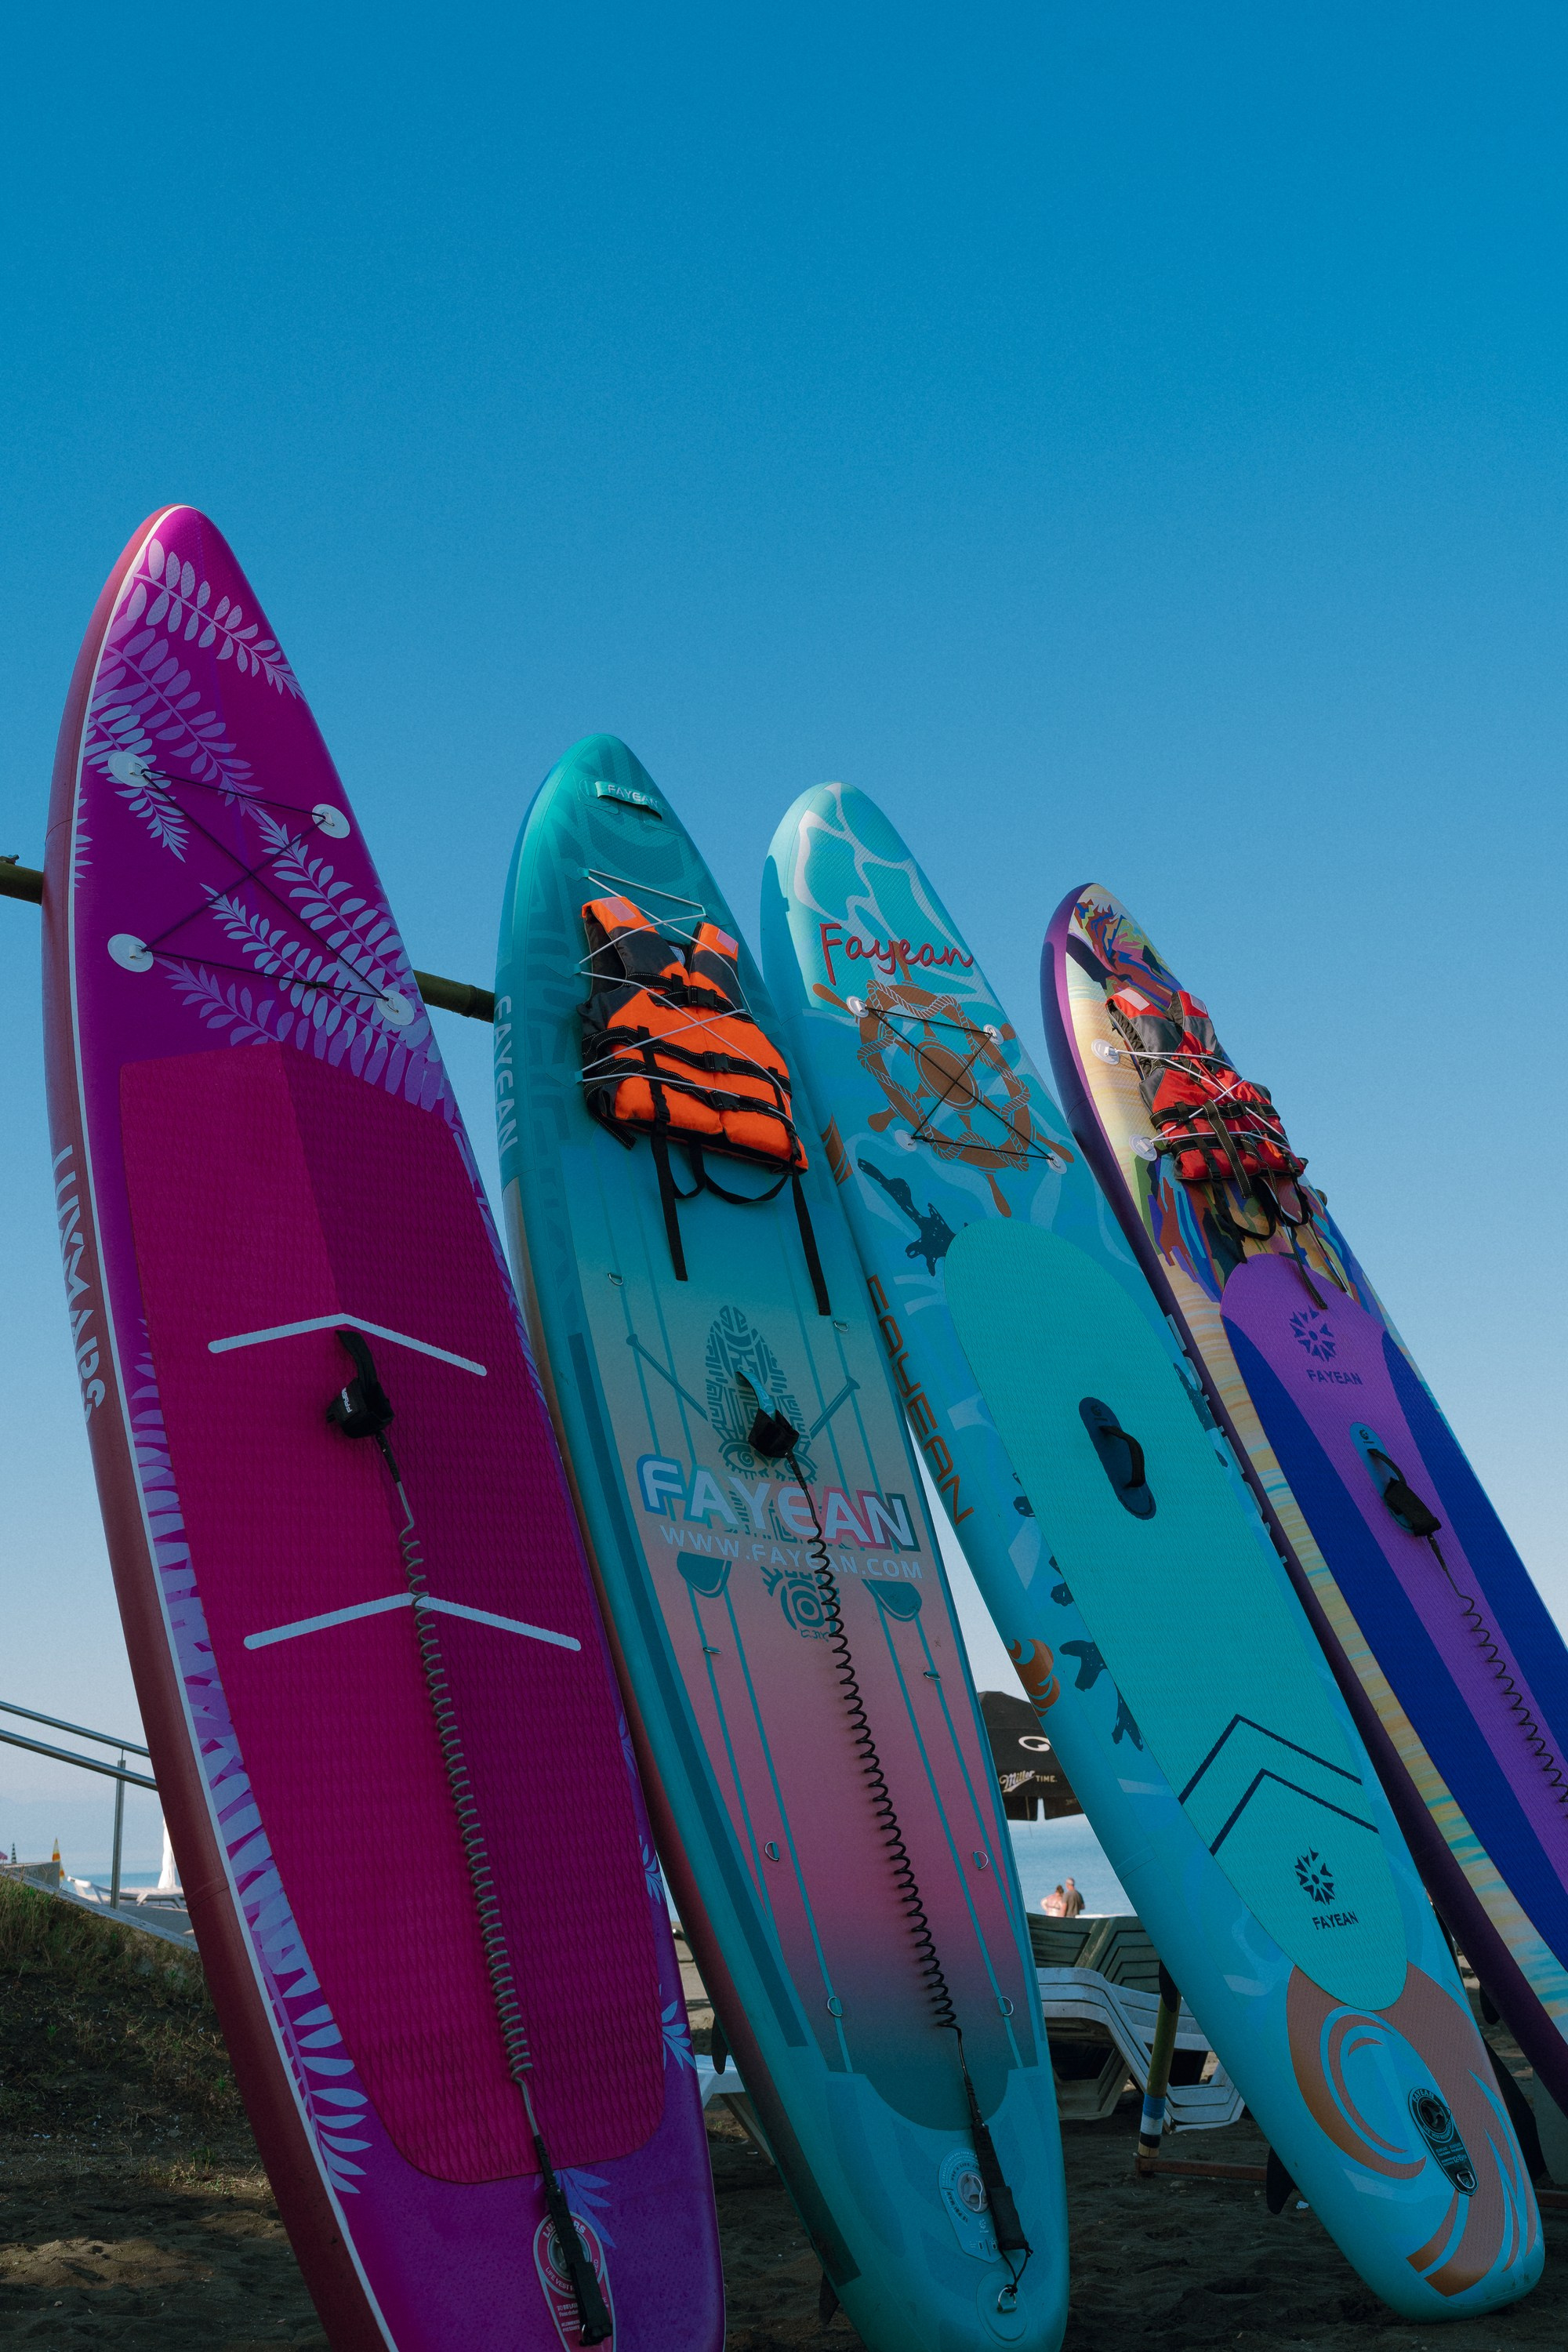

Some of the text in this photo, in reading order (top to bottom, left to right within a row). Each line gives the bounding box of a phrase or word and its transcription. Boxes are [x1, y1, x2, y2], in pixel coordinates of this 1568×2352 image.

[608, 784, 659, 809] FAYEAN
[818, 922, 975, 986] Fayean
[494, 994, 518, 1159] FAYEAN
[1305, 1369, 1363, 1385] FAYEAN
[637, 1454, 920, 1552] FAYEAN
[659, 1525, 924, 1579] WWW.FAYEAN.COM
[999, 1769, 1036, 1792] Miller
[1312, 1911, 1359, 1930] FAYEAN
[545, 2266, 556, 2281] LIFE
